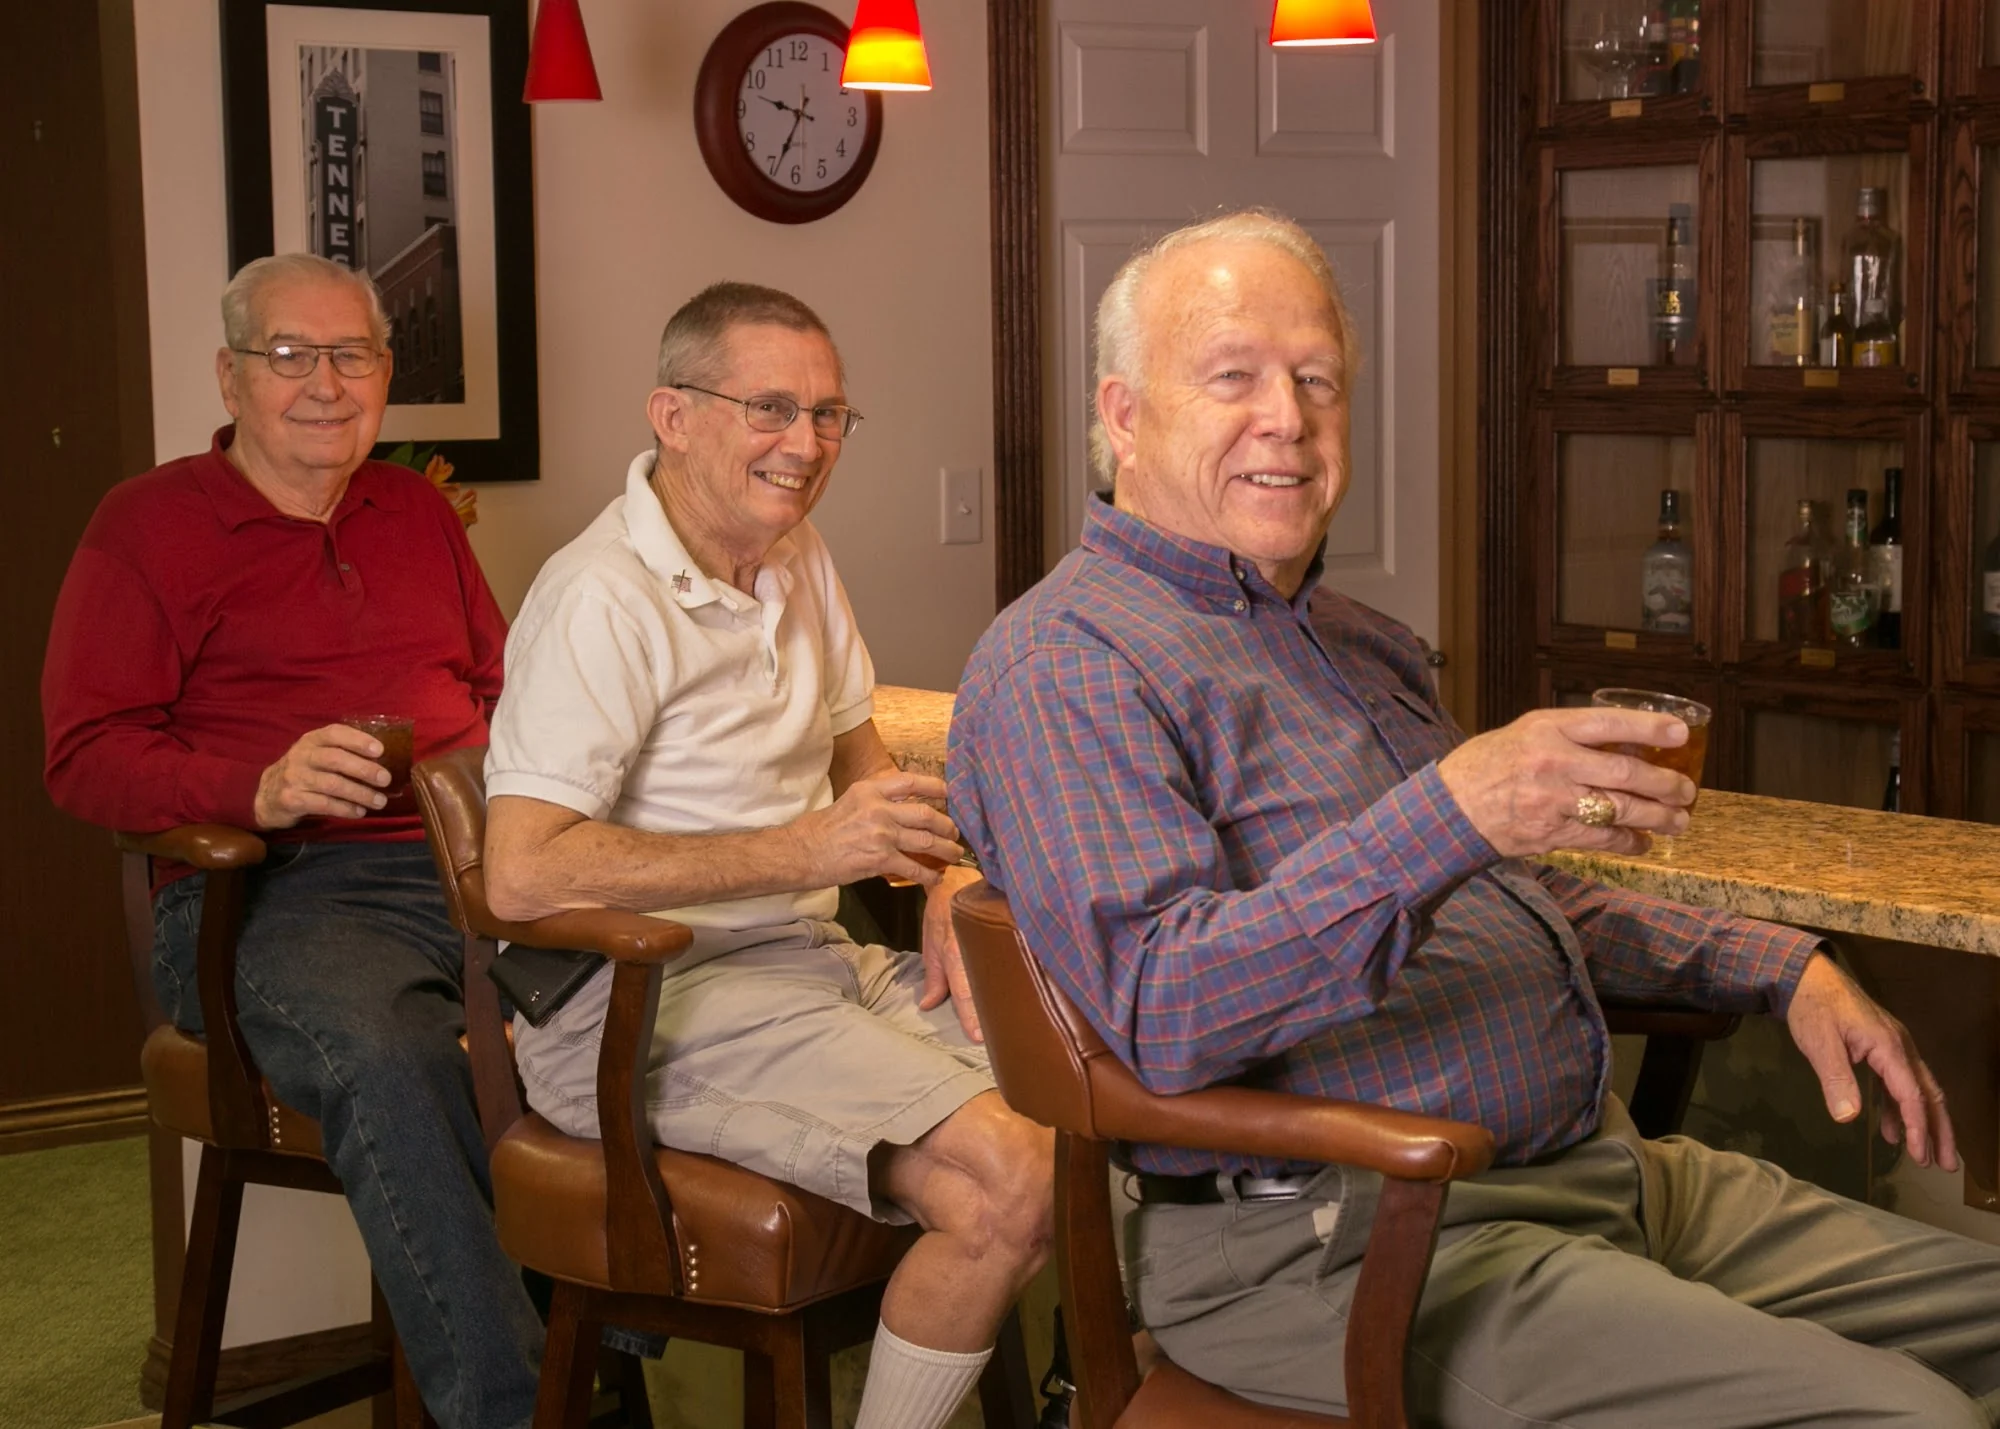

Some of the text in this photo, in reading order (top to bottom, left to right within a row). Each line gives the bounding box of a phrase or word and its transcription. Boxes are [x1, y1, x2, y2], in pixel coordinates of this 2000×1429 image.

[766, 48, 784, 68] 11
[789, 41, 808, 61] 12
[822, 53, 830, 71] 1
[747, 69, 766, 89] 10
[847, 106, 857, 127] 3
[745, 132, 755, 151] 8
[836, 138, 846, 157] 4
[767, 155, 777, 176] 7
[790, 164, 801, 185] 6
[816, 159, 827, 179] 5
